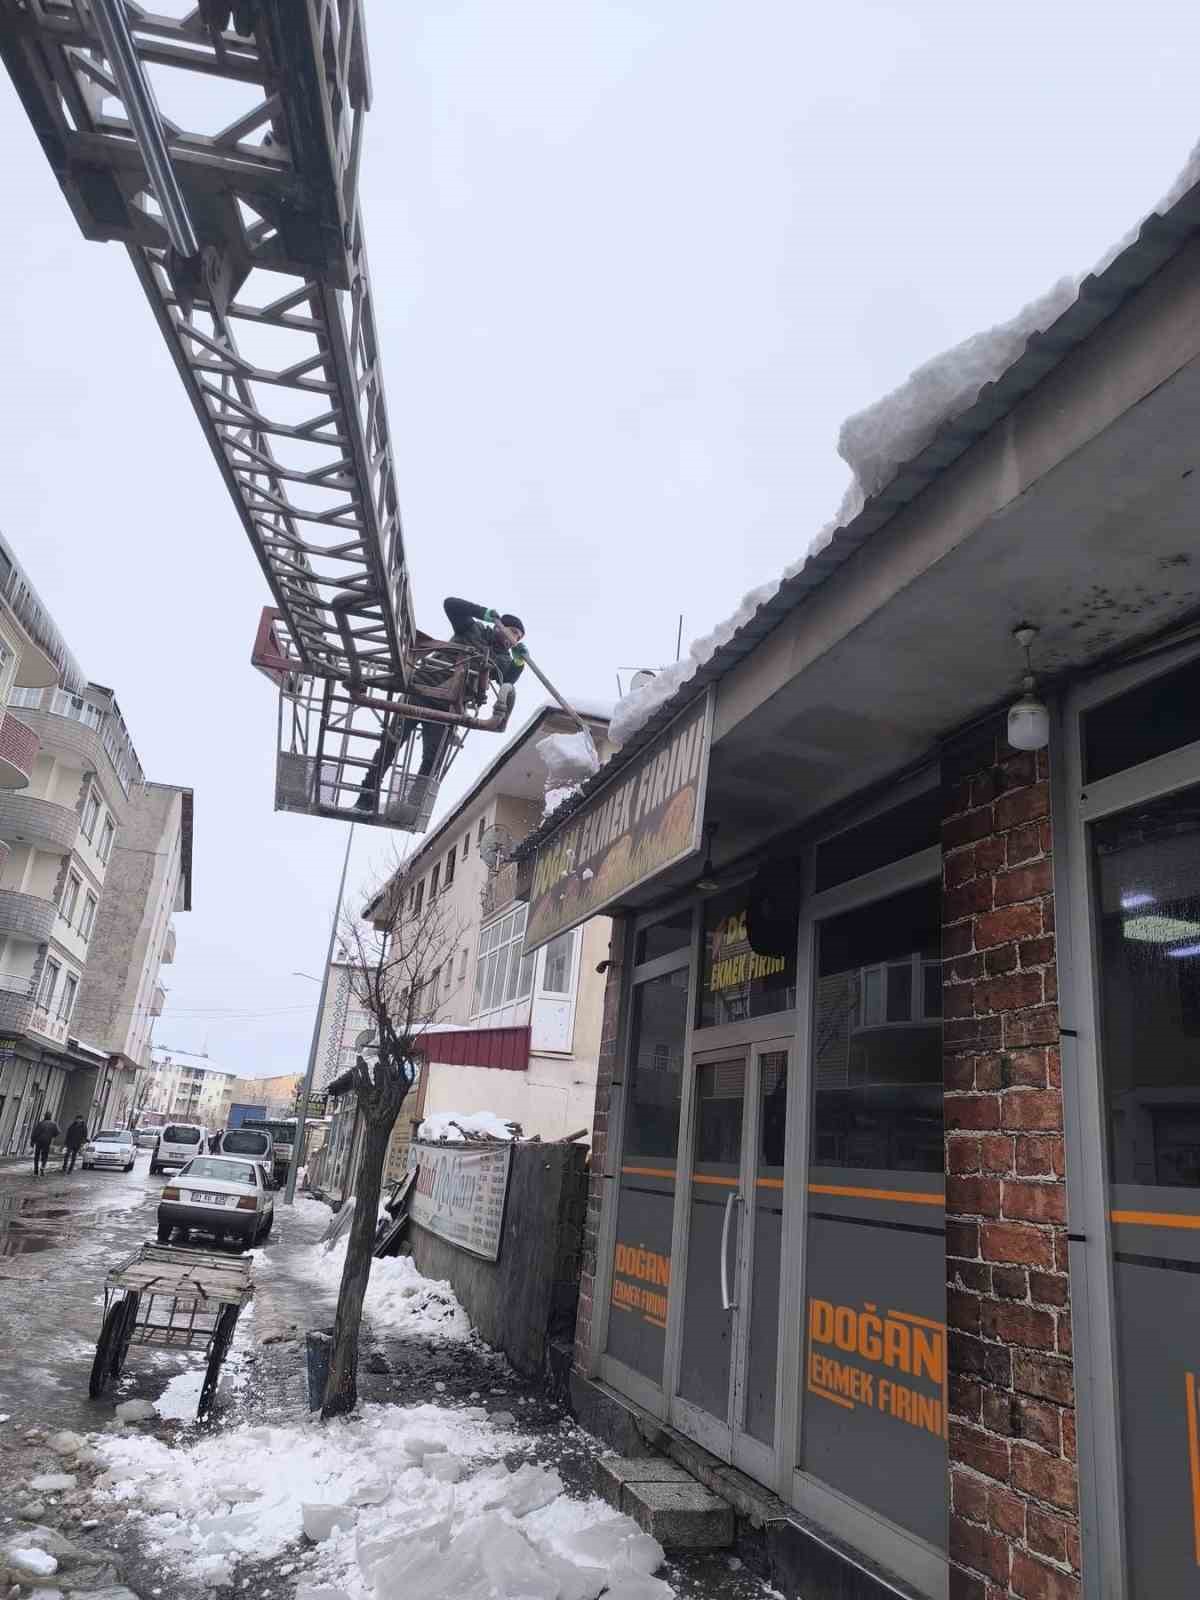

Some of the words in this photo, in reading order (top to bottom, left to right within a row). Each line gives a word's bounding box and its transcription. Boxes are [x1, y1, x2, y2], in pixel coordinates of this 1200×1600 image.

[576, 775, 637, 866] EKMEK
[634, 716, 706, 823] FIRINI
[614, 1280, 641, 1306] EKMEK
[616, 1244, 671, 1287] DOĞAN
[812, 1299, 943, 1384] DOĞAN
[811, 1351, 873, 1408] EKMEK
[877, 1379, 942, 1437] FIRINI
